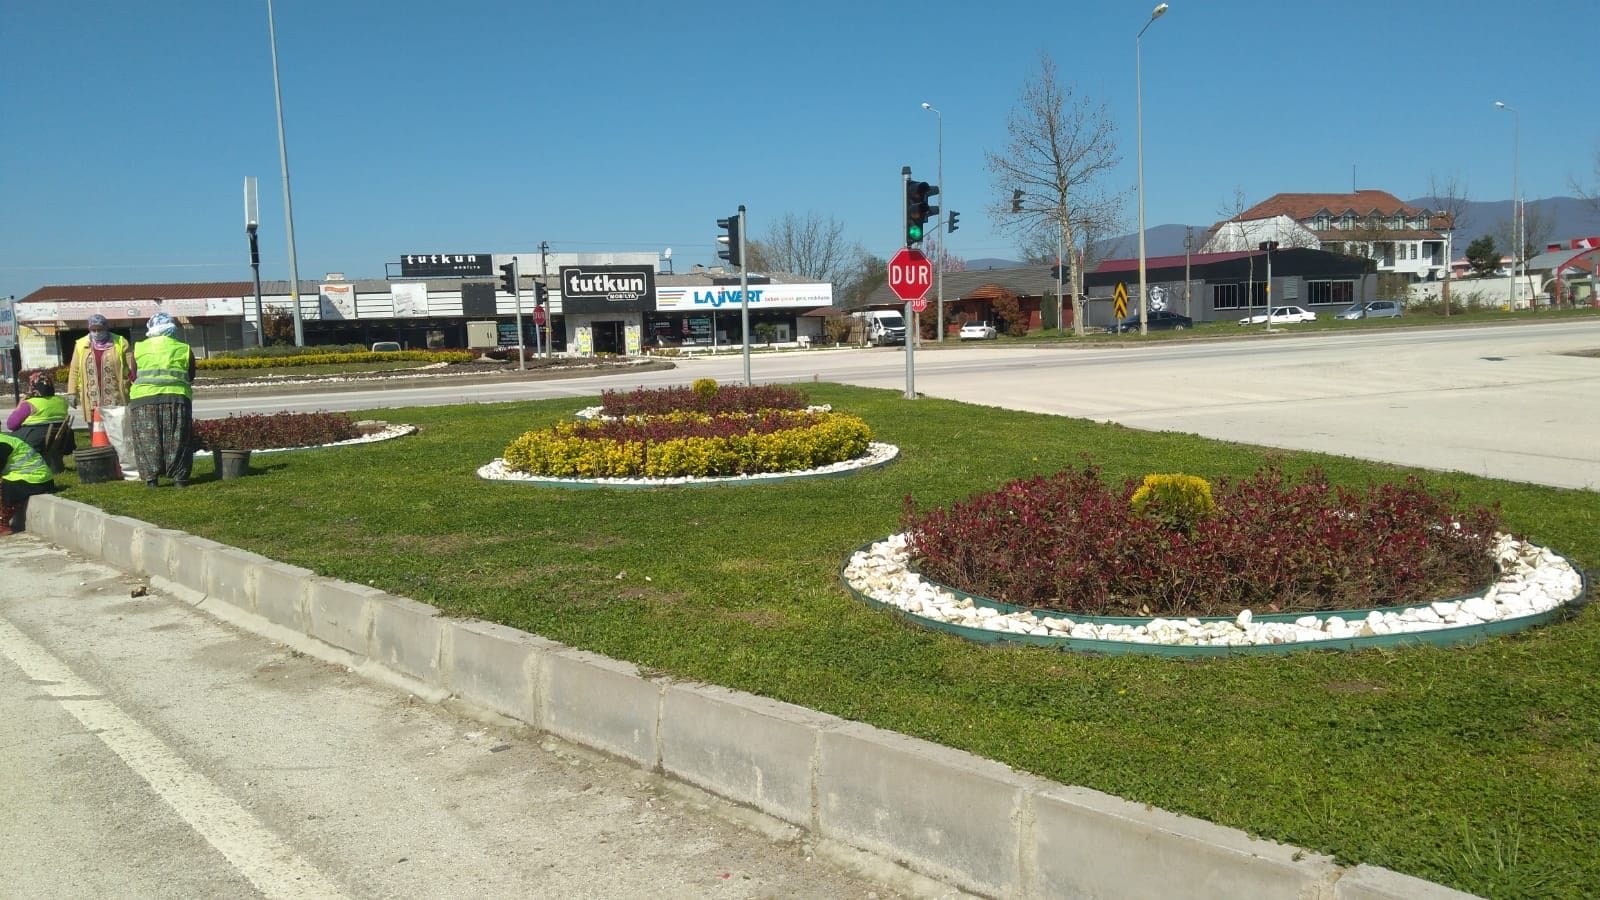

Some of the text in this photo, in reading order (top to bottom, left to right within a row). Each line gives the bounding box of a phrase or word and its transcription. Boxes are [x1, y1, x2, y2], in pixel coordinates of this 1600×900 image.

[407, 254, 477, 265] tutkun
[570, 275, 643, 292] tutkun
[892, 265, 928, 285] DUR
